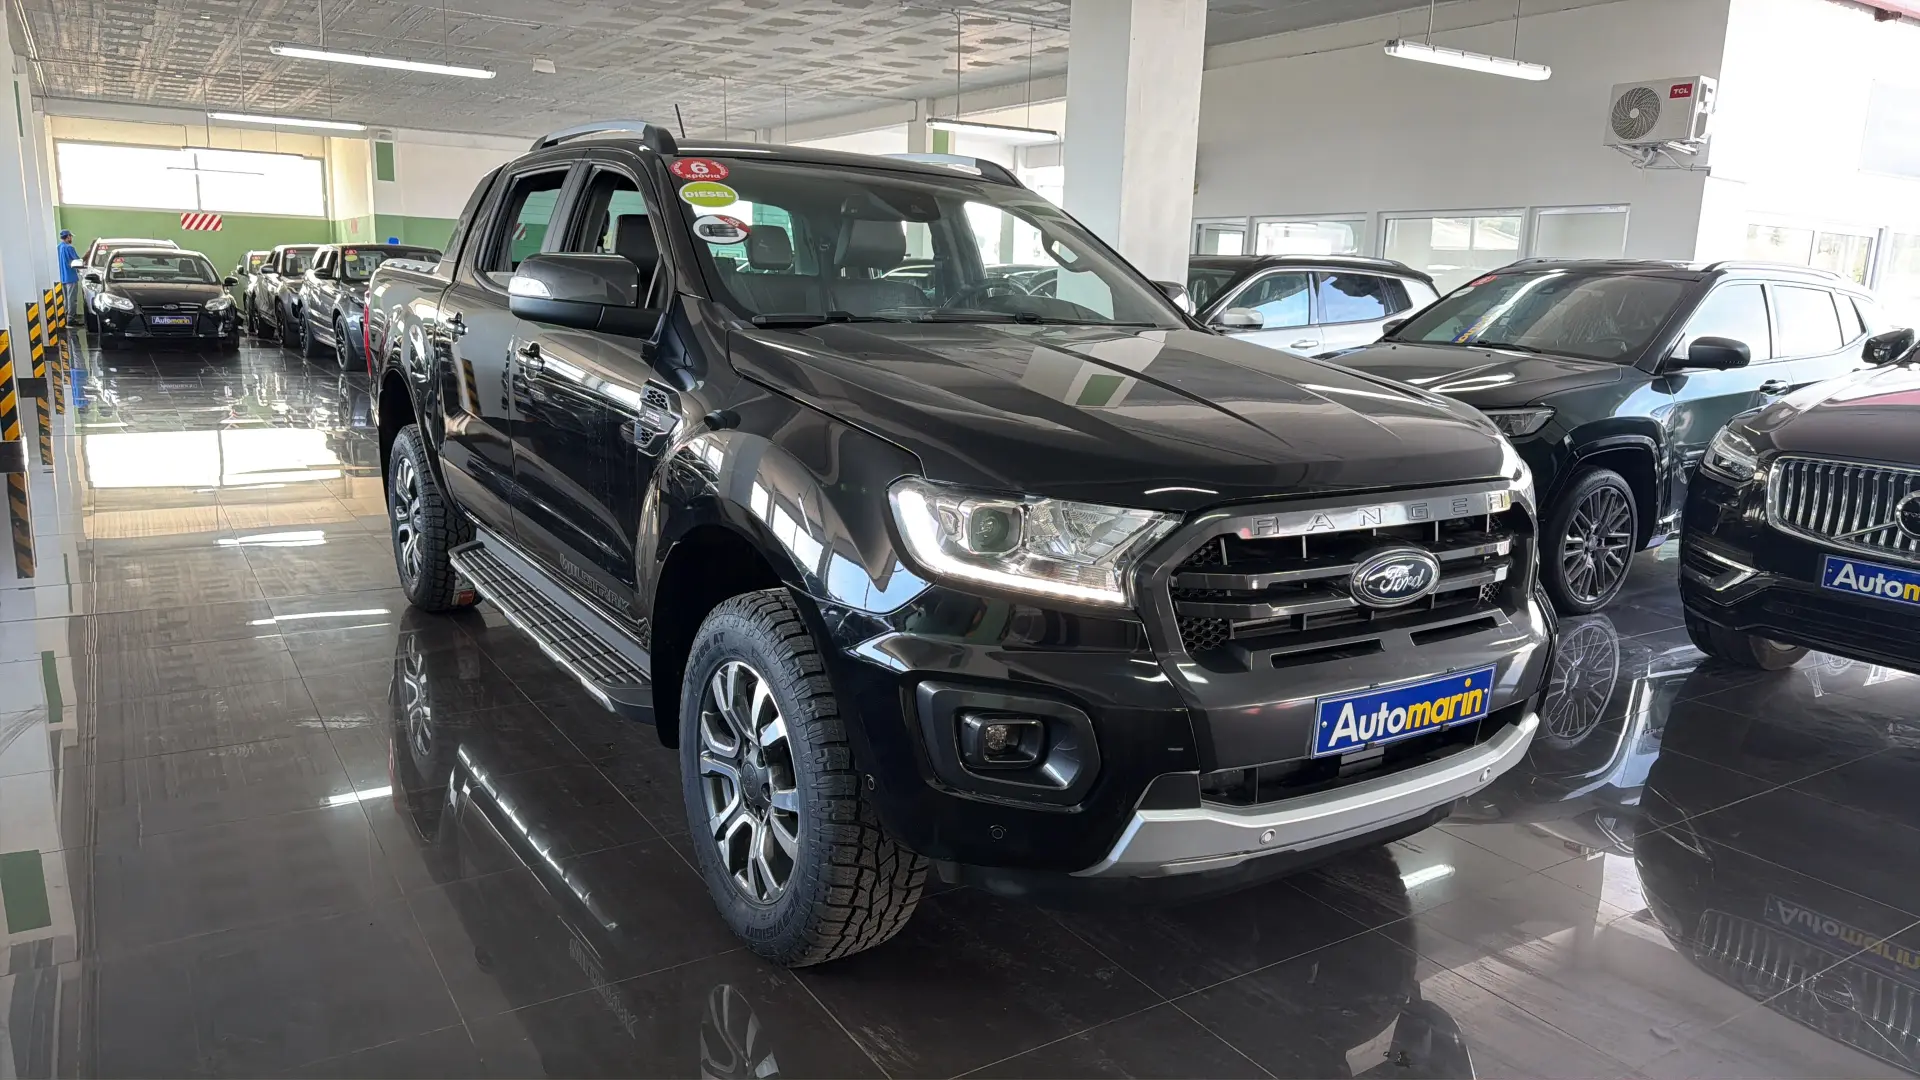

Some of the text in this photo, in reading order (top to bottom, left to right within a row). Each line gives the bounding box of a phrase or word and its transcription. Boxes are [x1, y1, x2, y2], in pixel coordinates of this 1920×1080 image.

[690, 162, 709, 174] 6
[1252, 490, 1511, 536] RANGER
[1379, 563, 1425, 593] Ford
[1328, 678, 1483, 748] Automarin
